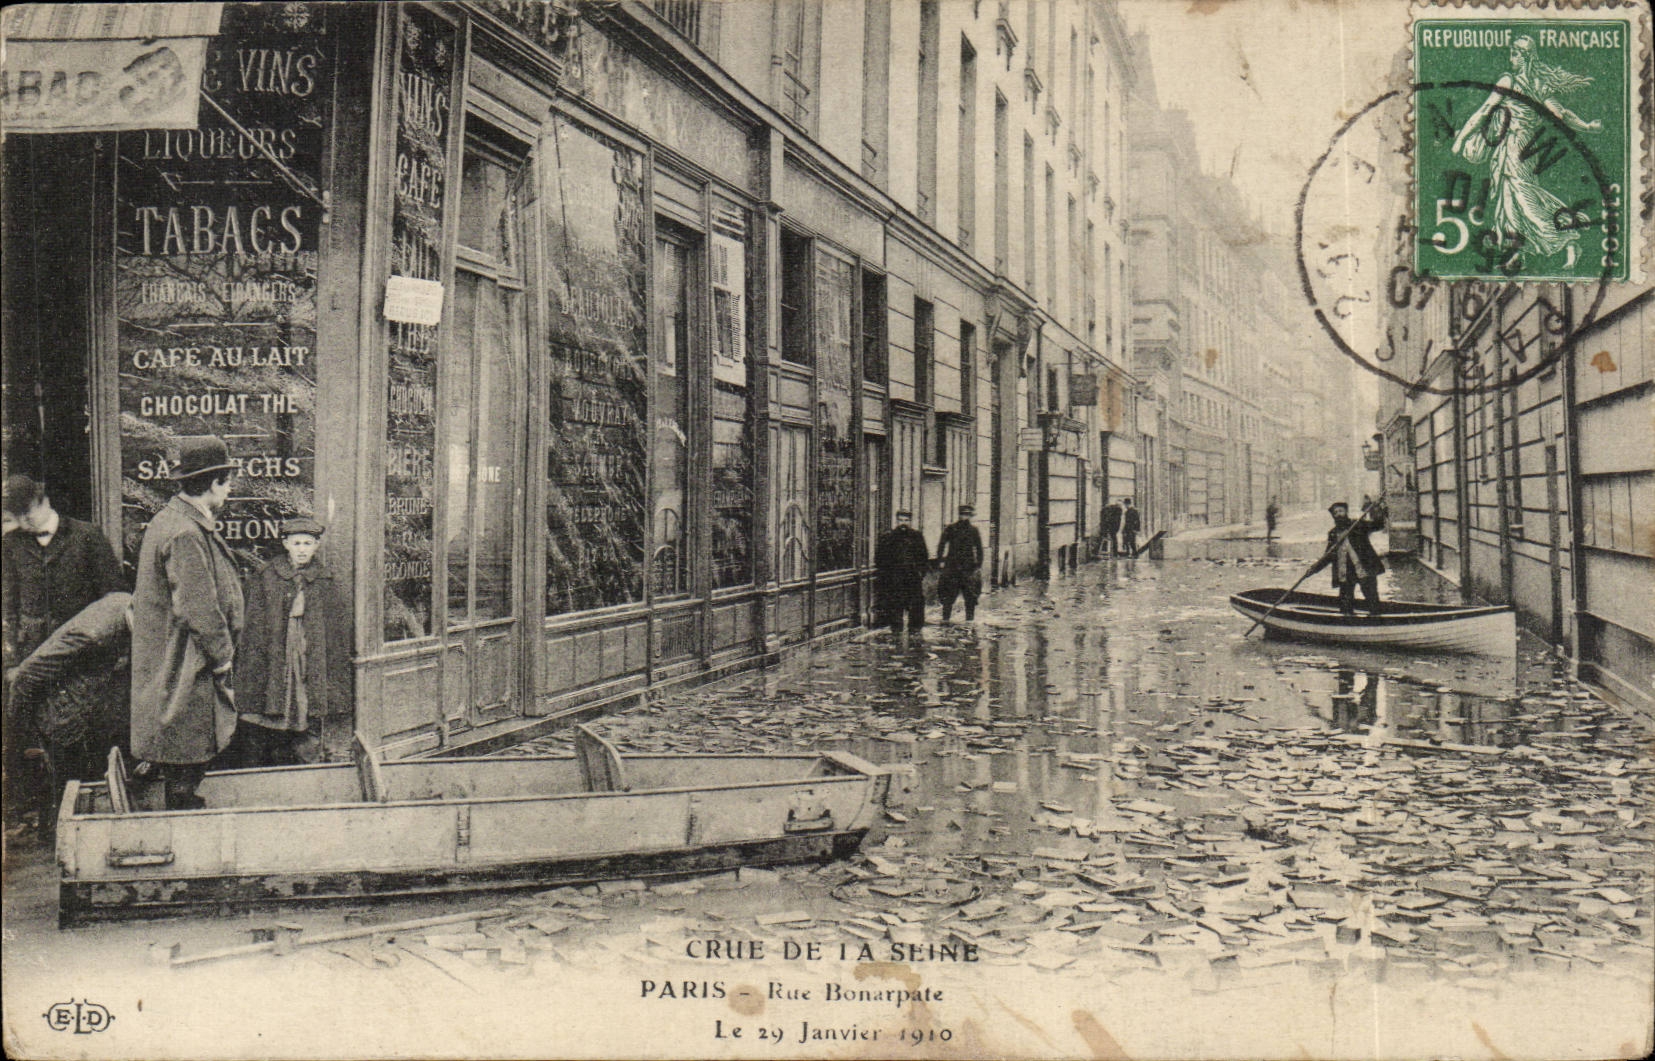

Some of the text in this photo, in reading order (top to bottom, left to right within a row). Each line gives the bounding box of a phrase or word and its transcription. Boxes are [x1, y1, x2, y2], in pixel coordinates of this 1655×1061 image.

[1540, 29, 1620, 50] FRANÇAISE
[236, 48, 316, 97] VINS
[143, 128, 297, 161] LIQUEURS
[135, 205, 302, 255] TABACS
[207, 346, 243, 368] AU
[250, 346, 309, 367] LAIT
[140, 393, 298, 417] CHOCOLAT THE
[137, 456, 301, 480] SAICHS
